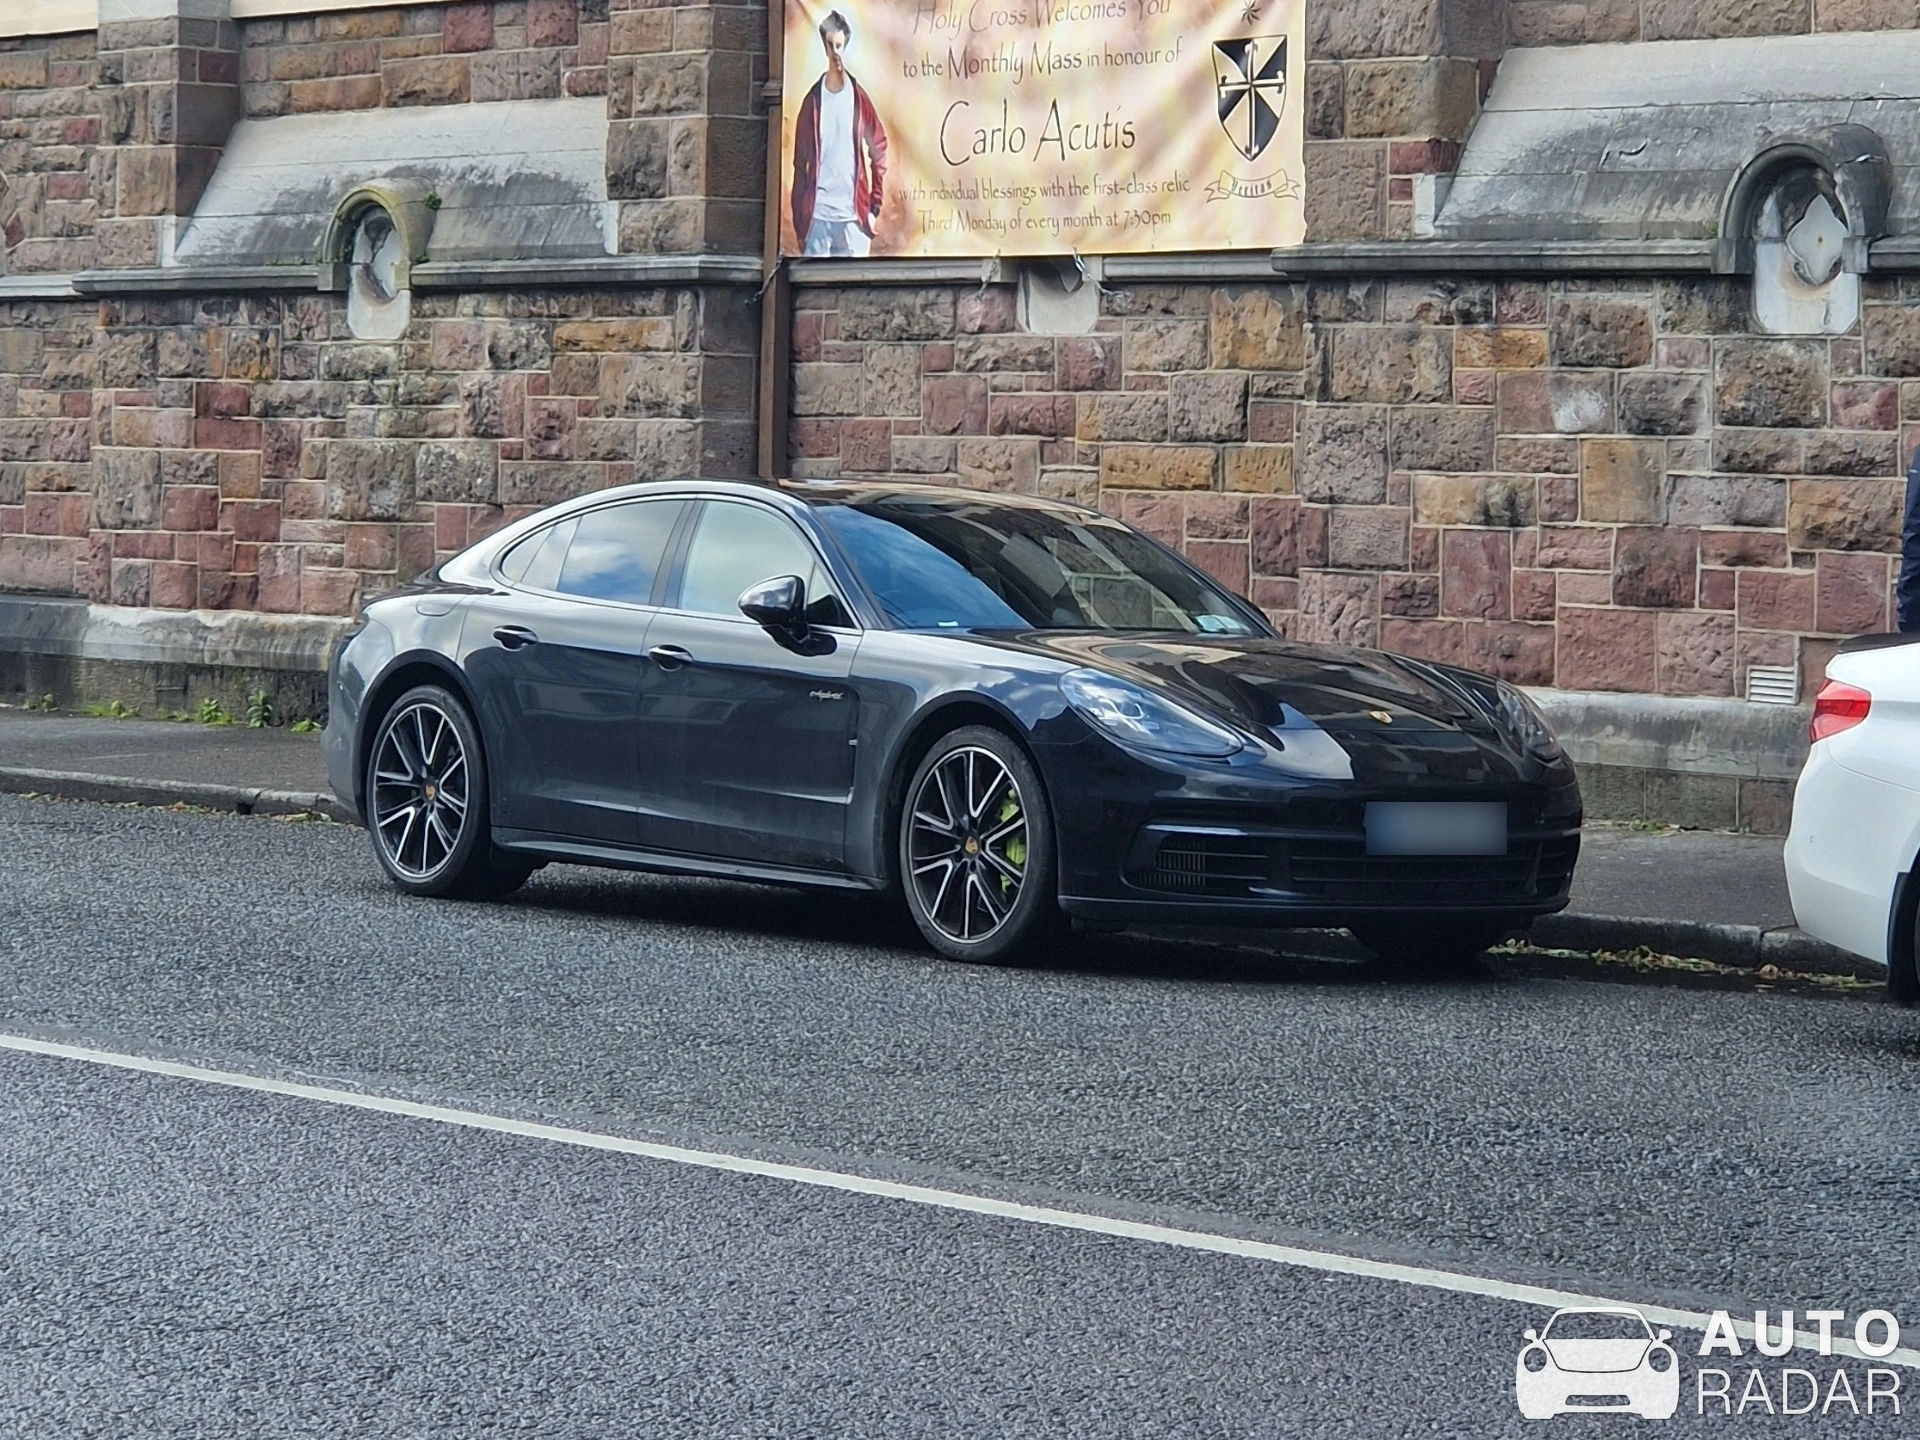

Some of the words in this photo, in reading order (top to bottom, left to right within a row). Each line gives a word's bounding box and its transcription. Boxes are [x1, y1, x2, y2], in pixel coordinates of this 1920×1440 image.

[912, 0, 963, 41] Holy
[968, 0, 1028, 33] Cross
[1035, 0, 1127, 29] Welcomes
[1132, 0, 1171, 21] You
[903, 60, 918, 78] to
[921, 52, 944, 77] the
[948, 41, 1024, 85] Monthly
[1030, 40, 1082, 76] Mass
[1087, 48, 1100, 67] in
[1104, 41, 1161, 67] honour
[1165, 35, 1183, 63] of
[939, 97, 1026, 166] Carlo
[1032, 97, 1136, 162] Acutis
[899, 178, 926, 200] with
[929, 177, 980, 200] individual
[981, 177, 1037, 206] blessings
[1039, 174, 1066, 197] with
[1068, 173, 1090, 196] the
[1093, 171, 1158, 195] first-class
[1161, 169, 1191, 193] relic
[917, 209, 954, 234] Third
[956, 208, 1007, 238] Monday
[1009, 206, 1023, 229] of
[1026, 216, 1060, 238] every
[1063, 205, 1103, 228] month
[1105, 210, 1119, 227] at
[1123, 209, 1172, 235] 7:30pm
